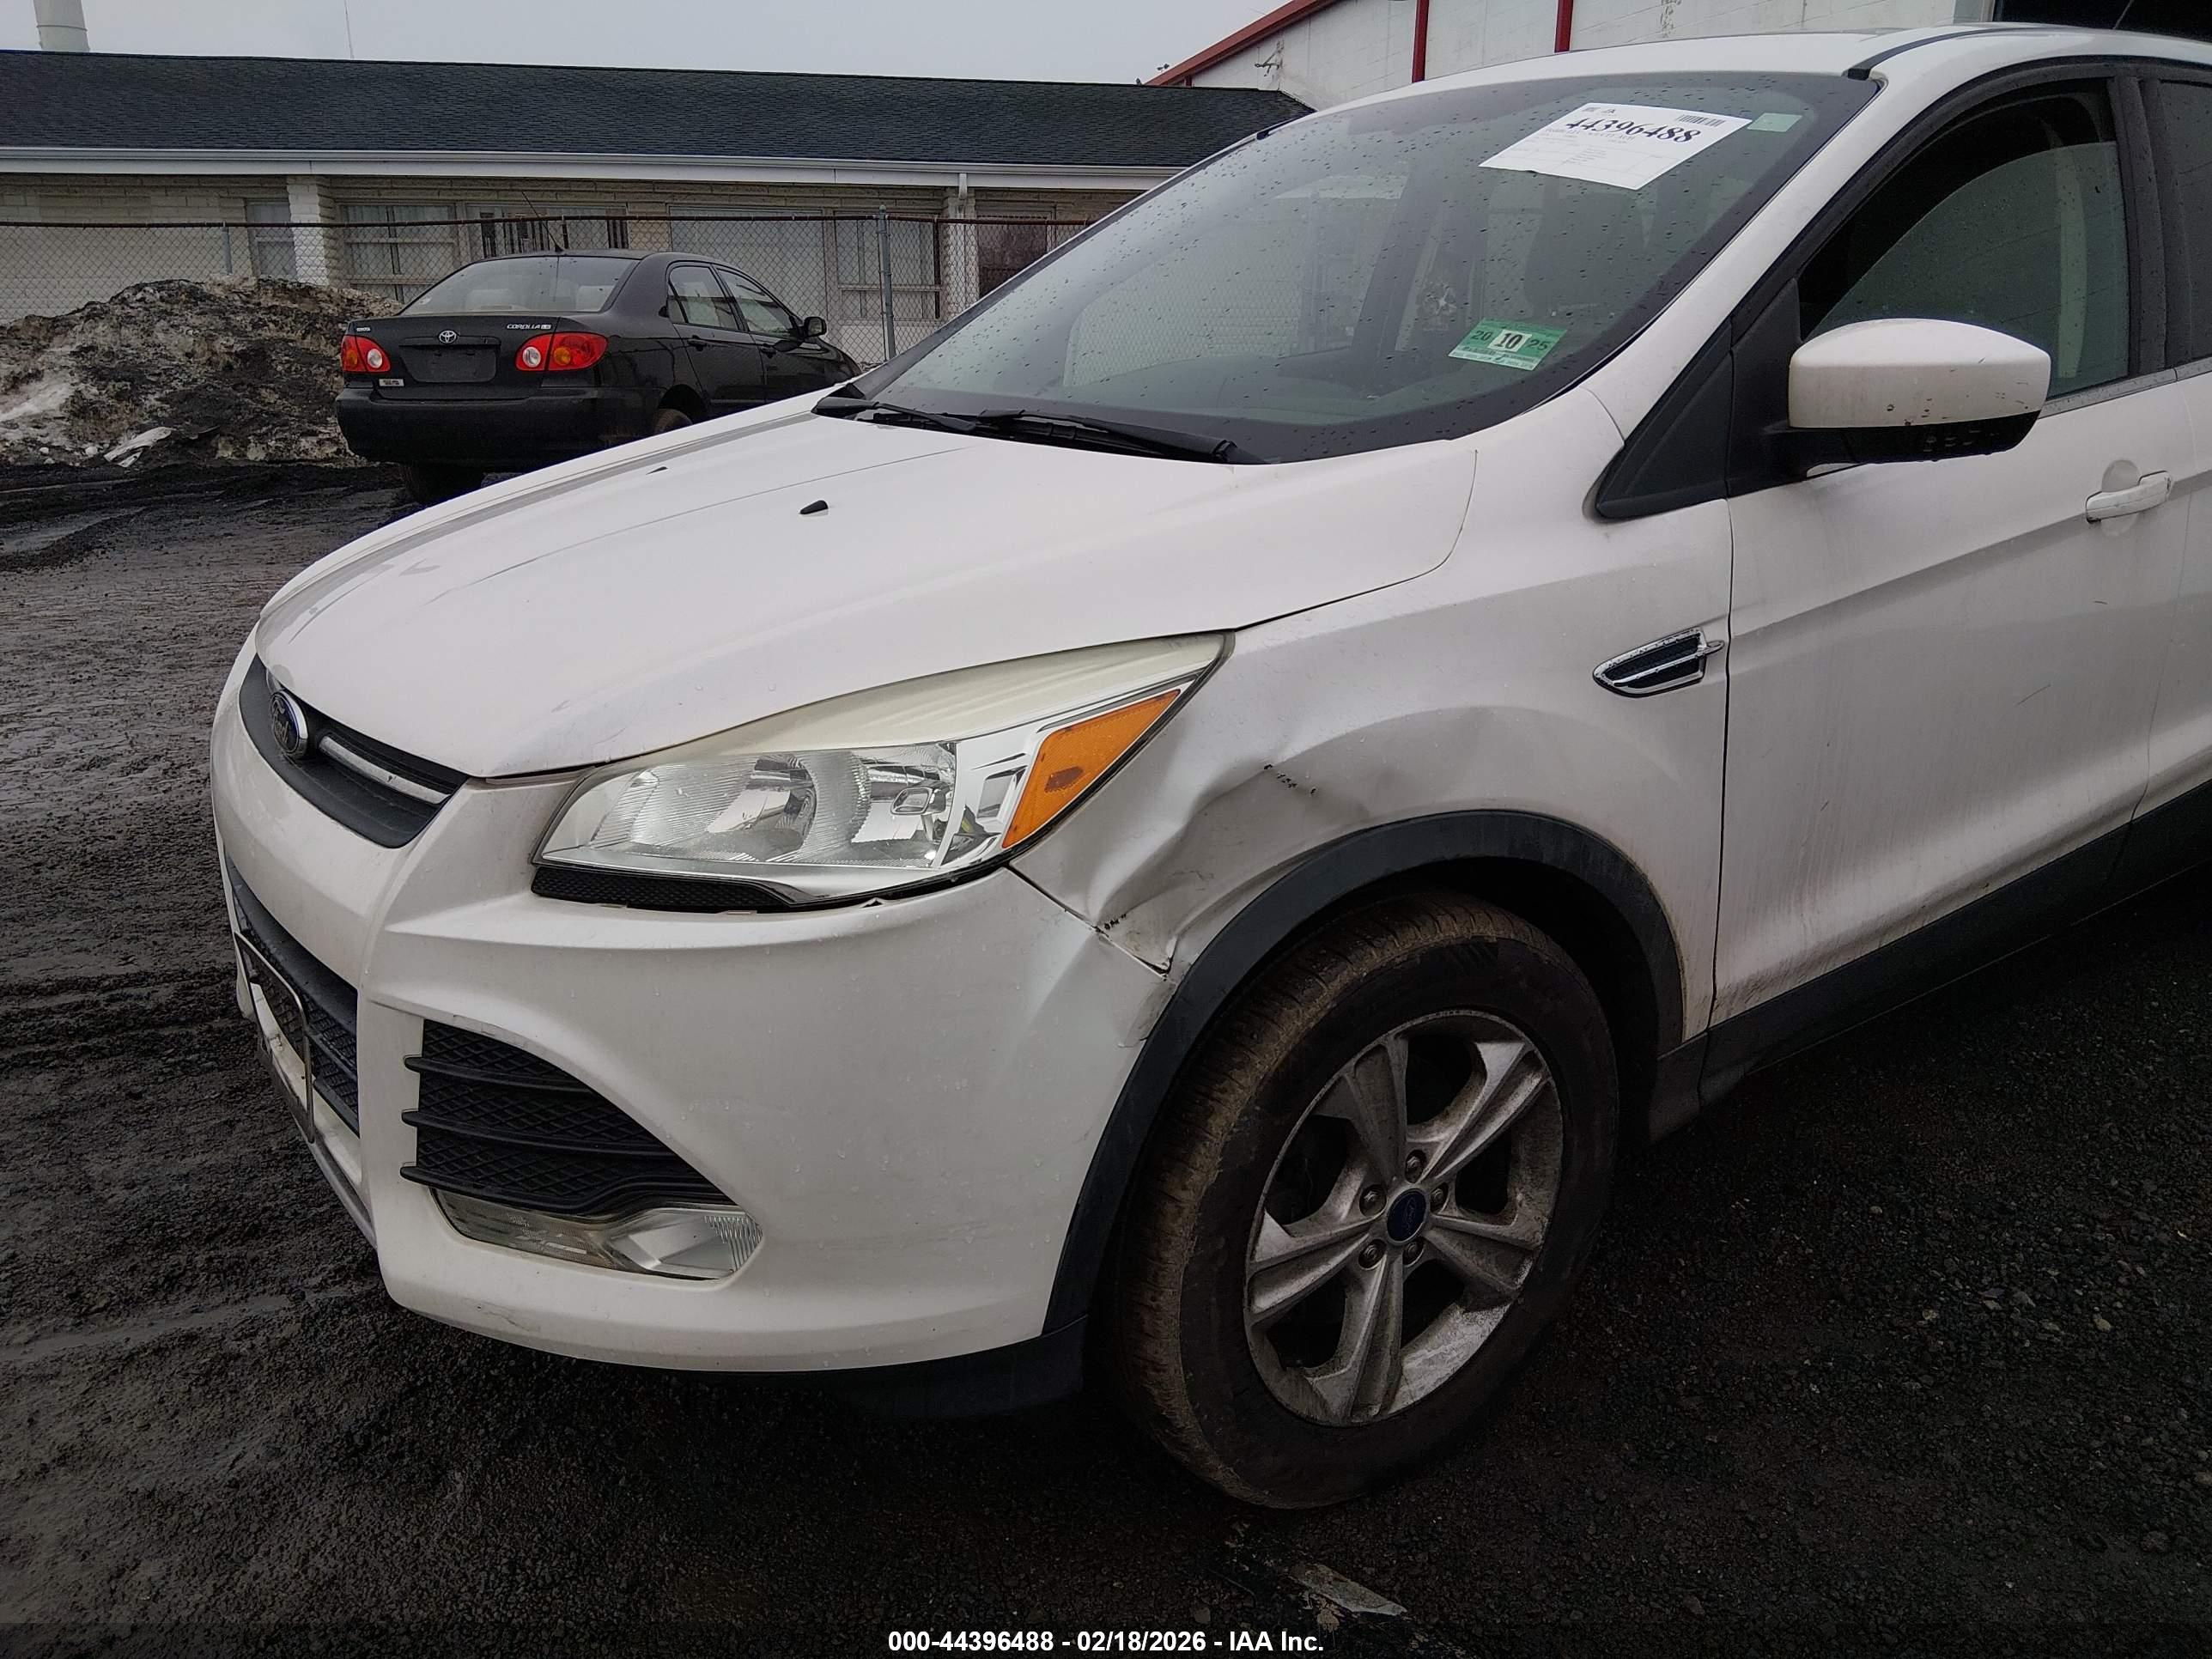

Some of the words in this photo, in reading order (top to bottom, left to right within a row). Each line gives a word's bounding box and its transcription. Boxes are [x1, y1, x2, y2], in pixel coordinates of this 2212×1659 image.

[1565, 117, 1701, 143] 44396488
[1471, 330, 1493, 342] 20
[1494, 333, 1523, 349] 10
